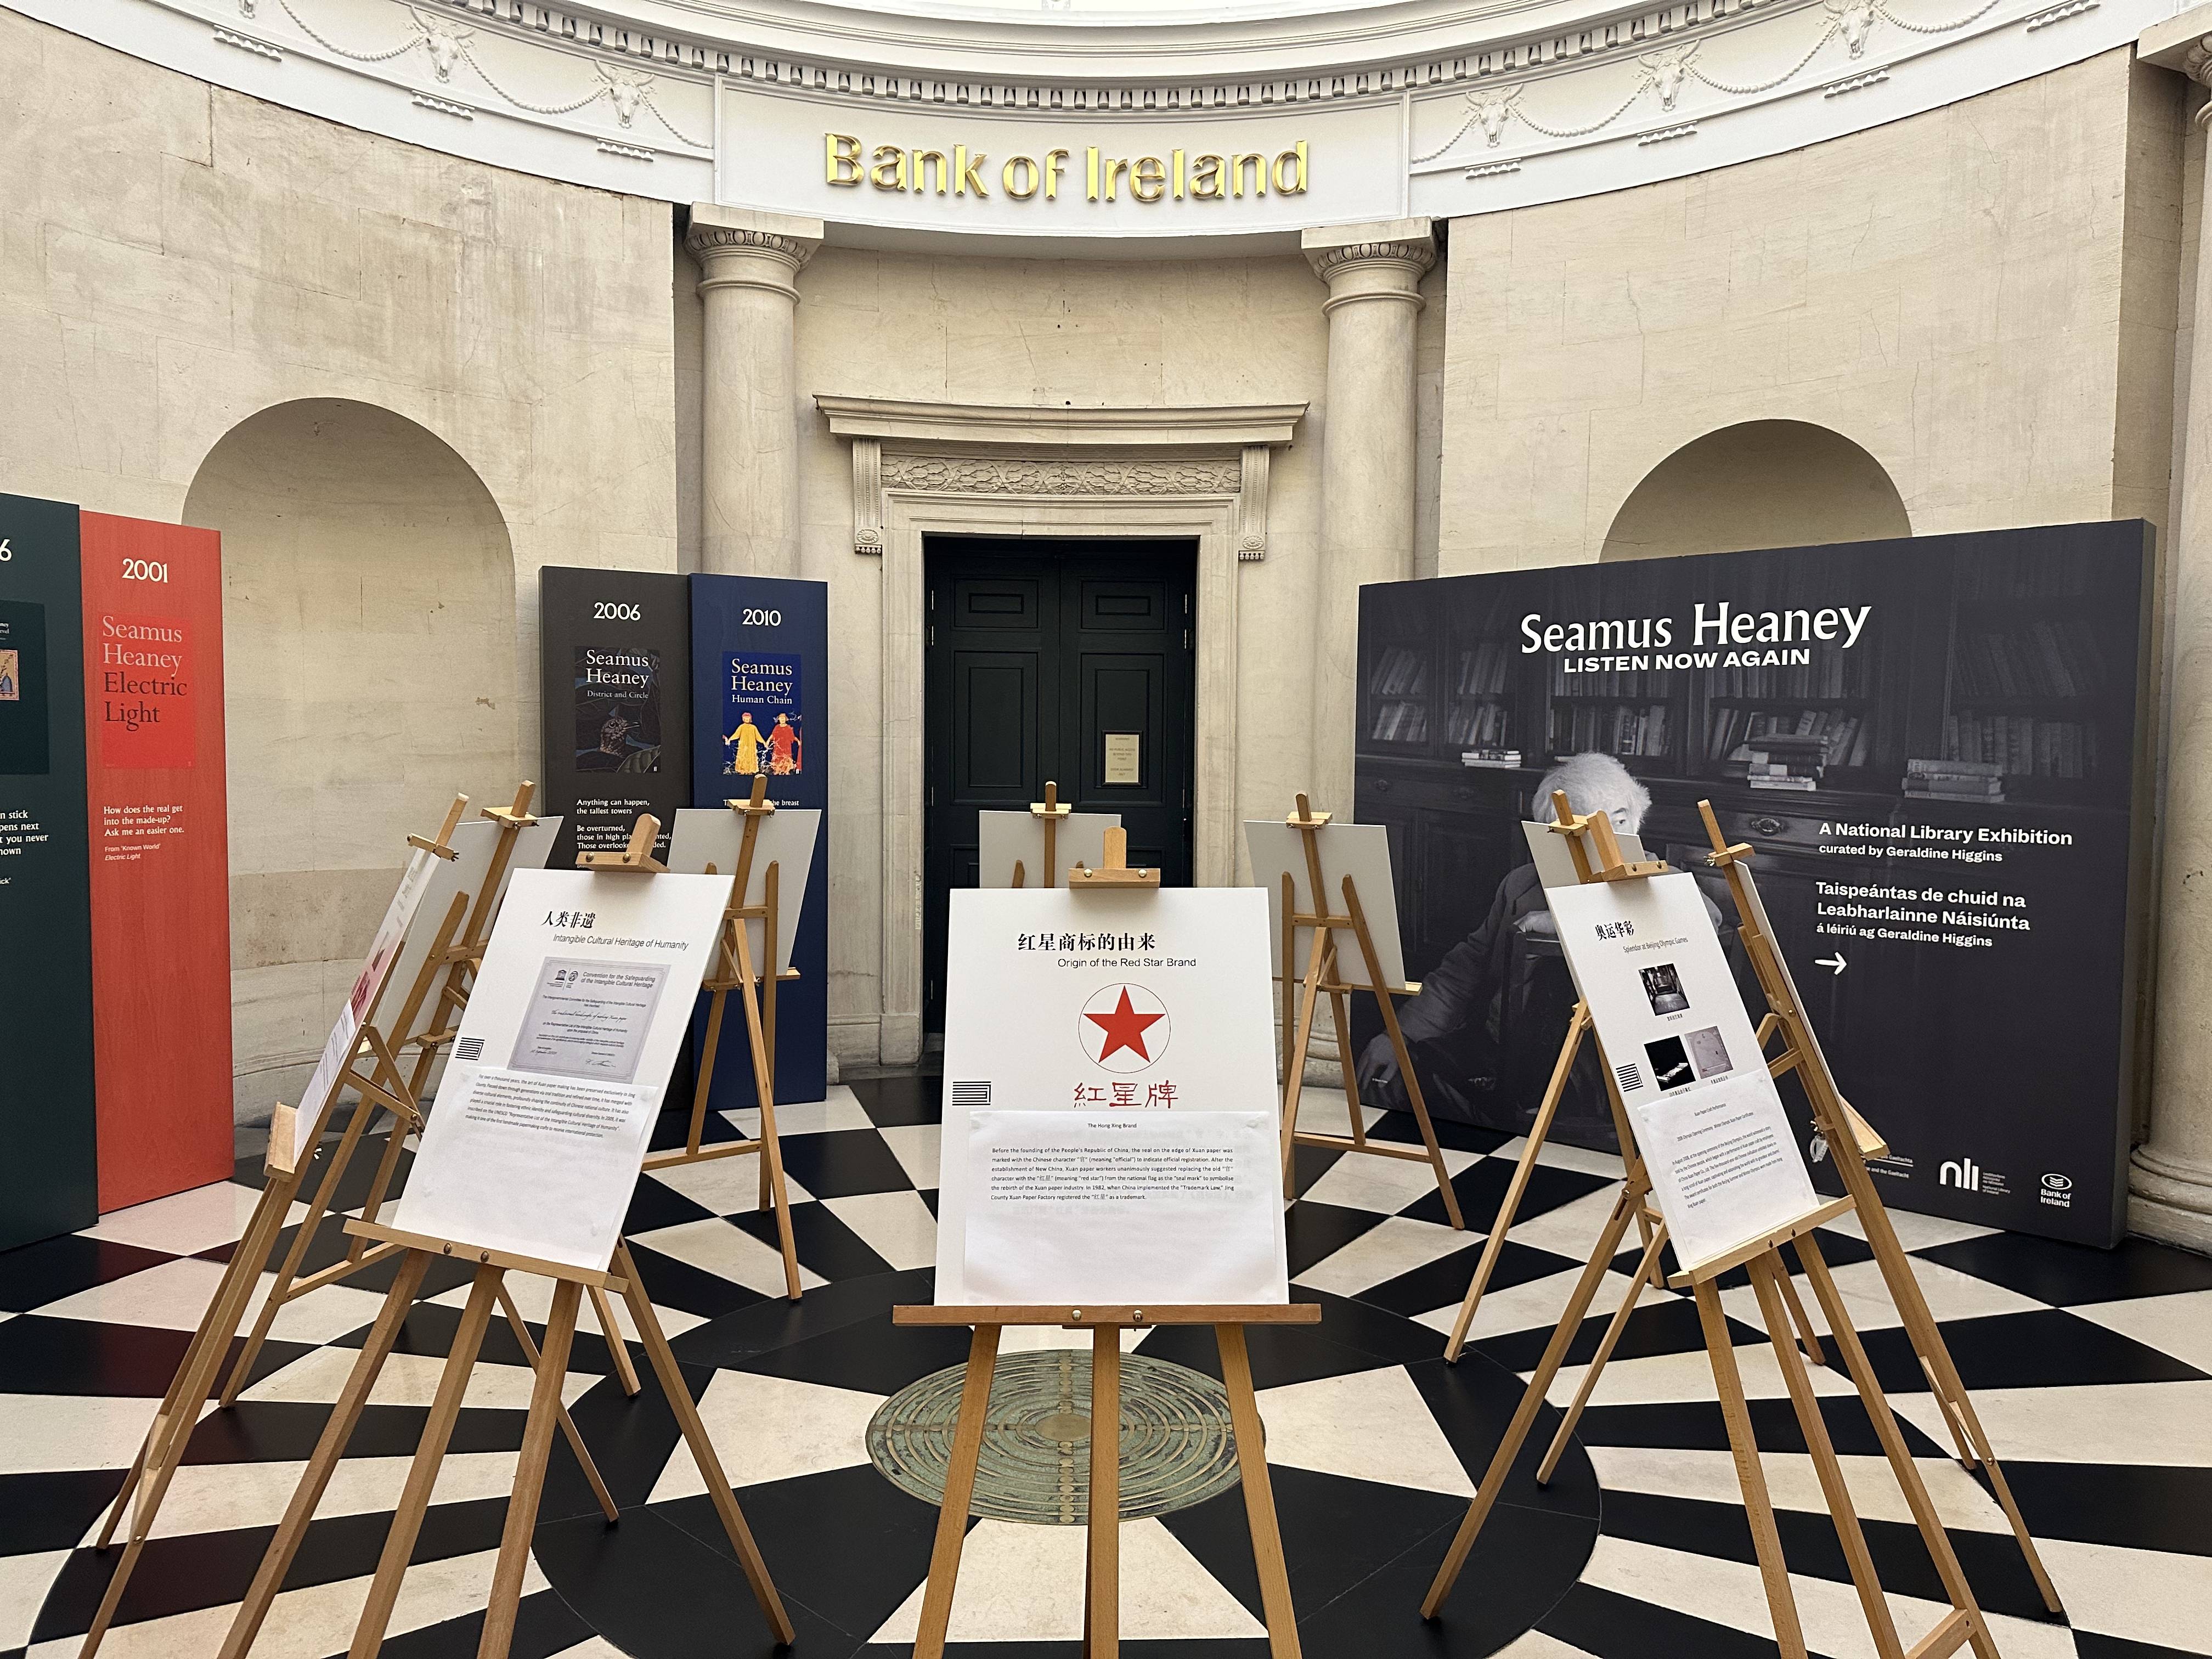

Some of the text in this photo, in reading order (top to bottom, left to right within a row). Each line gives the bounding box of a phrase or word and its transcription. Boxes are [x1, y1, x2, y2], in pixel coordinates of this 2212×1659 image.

[824, 132, 1308, 202] Bank of Ireland
[122, 558, 168, 584] 2001
[594, 602, 641, 622] 2006
[742, 608, 781, 627] 2010
[102, 616, 182, 643] Seamus
[1521, 601, 1872, 653] Seamus Heaney
[103, 643, 182, 677] Heaney
[586, 650, 649, 667] Seamus
[731, 658, 793, 675] Seamus
[1564, 648, 1810, 674] LISTEN NOW AGAIN
[104, 672, 188, 696] Electric
[586, 668, 649, 688] Heaney
[731, 676, 793, 696] Heaney
[587, 690, 612, 698] District
[628, 690, 649, 699] Circle
[732, 695, 793, 705] Human Chain
[104, 701, 161, 732] Light
[8, 810, 28, 819] stick
[104, 806, 121, 814] How
[172, 805, 183, 814] get
[136, 815, 171, 824] made-up?
[146, 826, 167, 834] easier
[1819, 822, 2073, 845] A National Library Exhibition
[6, 836, 22, 844] you
[1819, 844, 2003, 863] curated by Geraldine Higgins
[1816, 882, 2027, 908] Taispeántas de chuid na
[541, 911, 596, 929] 人类非遗
[1817, 902, 2030, 931] Leabharlainne Náisiúnta
[1595, 921, 1634, 941] 奥运华彩
[1816, 923, 1993, 947] á léiriú ag Geraldine Higgins
[552, 934, 689, 951] Intangible Cultural Heritage of Humanity
[1017, 933, 1156, 952] 红星商标的由来
[1623, 944, 1641, 953] Splendor
[1646, 941, 1661, 950] Beijing
[1659, 939, 1675, 948] Olympic
[1057, 958, 1197, 969] Origin of the Red Star Brand
[1073, 1080, 1179, 1109] 紅星牌
[2040, 1196, 2070, 1208] Ireland
[2041, 1188, 2062, 1199] Bank
